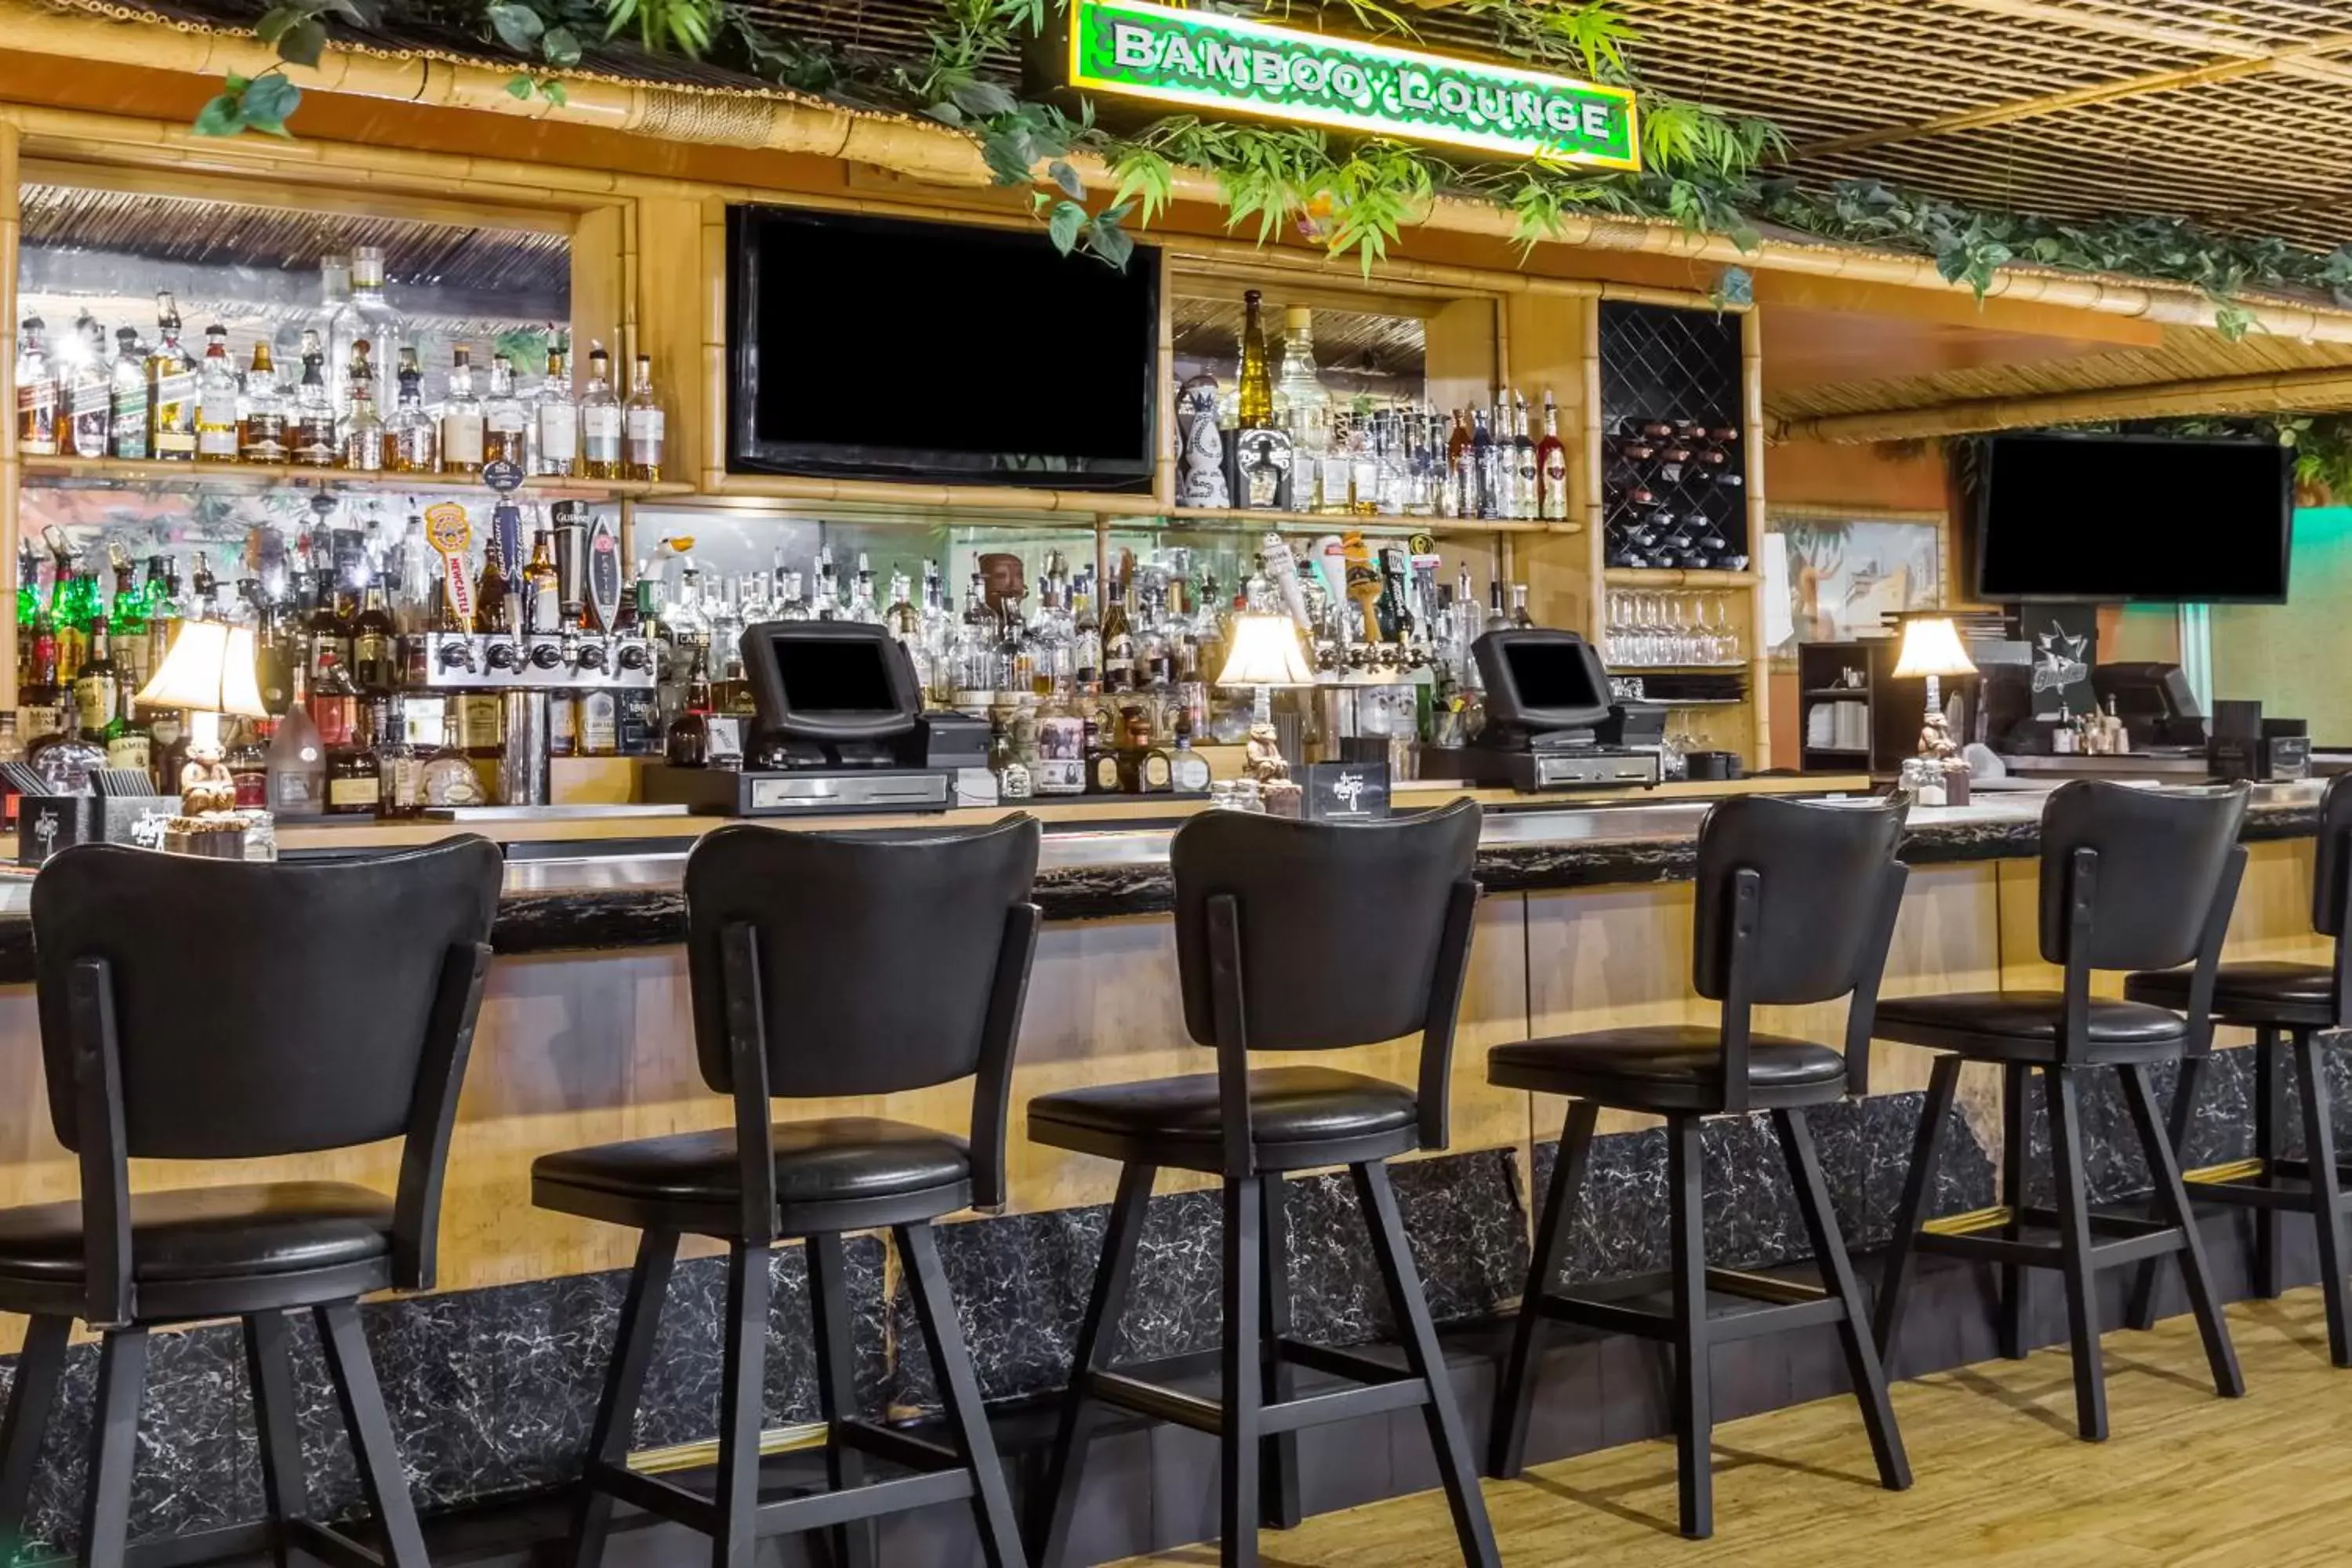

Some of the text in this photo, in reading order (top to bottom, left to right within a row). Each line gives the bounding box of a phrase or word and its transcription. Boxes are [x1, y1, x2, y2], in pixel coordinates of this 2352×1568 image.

[1112, 22, 1610, 140] BAMBOO LOUNGE
[449, 557, 470, 615] NEWCASTLE
